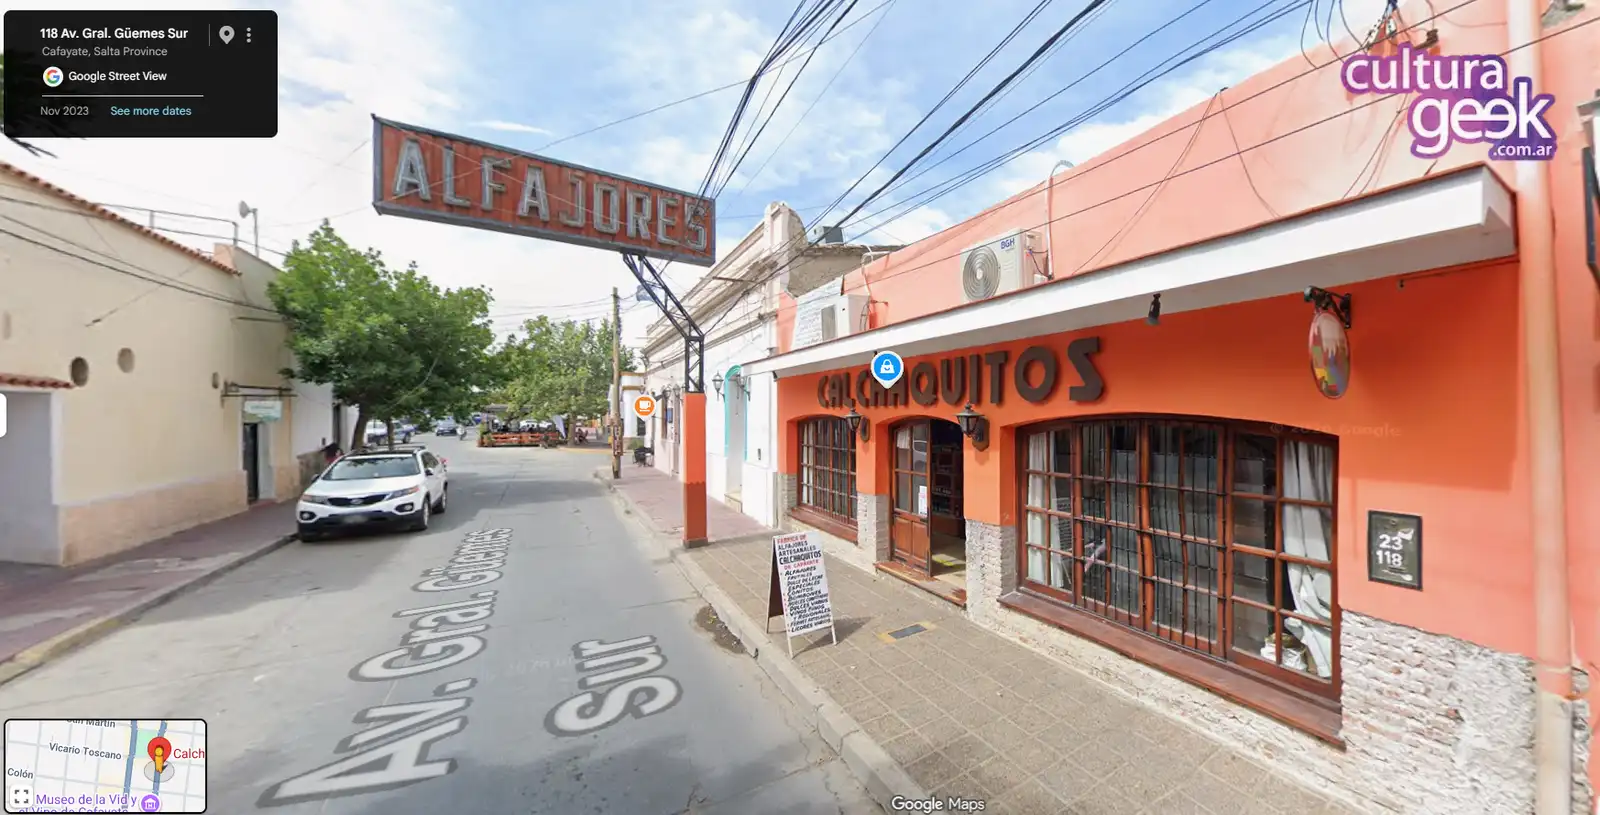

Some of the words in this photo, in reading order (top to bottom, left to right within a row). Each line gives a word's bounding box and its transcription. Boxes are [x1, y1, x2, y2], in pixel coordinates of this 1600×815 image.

[393, 136, 707, 251] ALFAJORES
[1000, 237, 1016, 250] BGH
[1378, 533, 1403, 550] 23
[1376, 550, 1403, 567] 118
